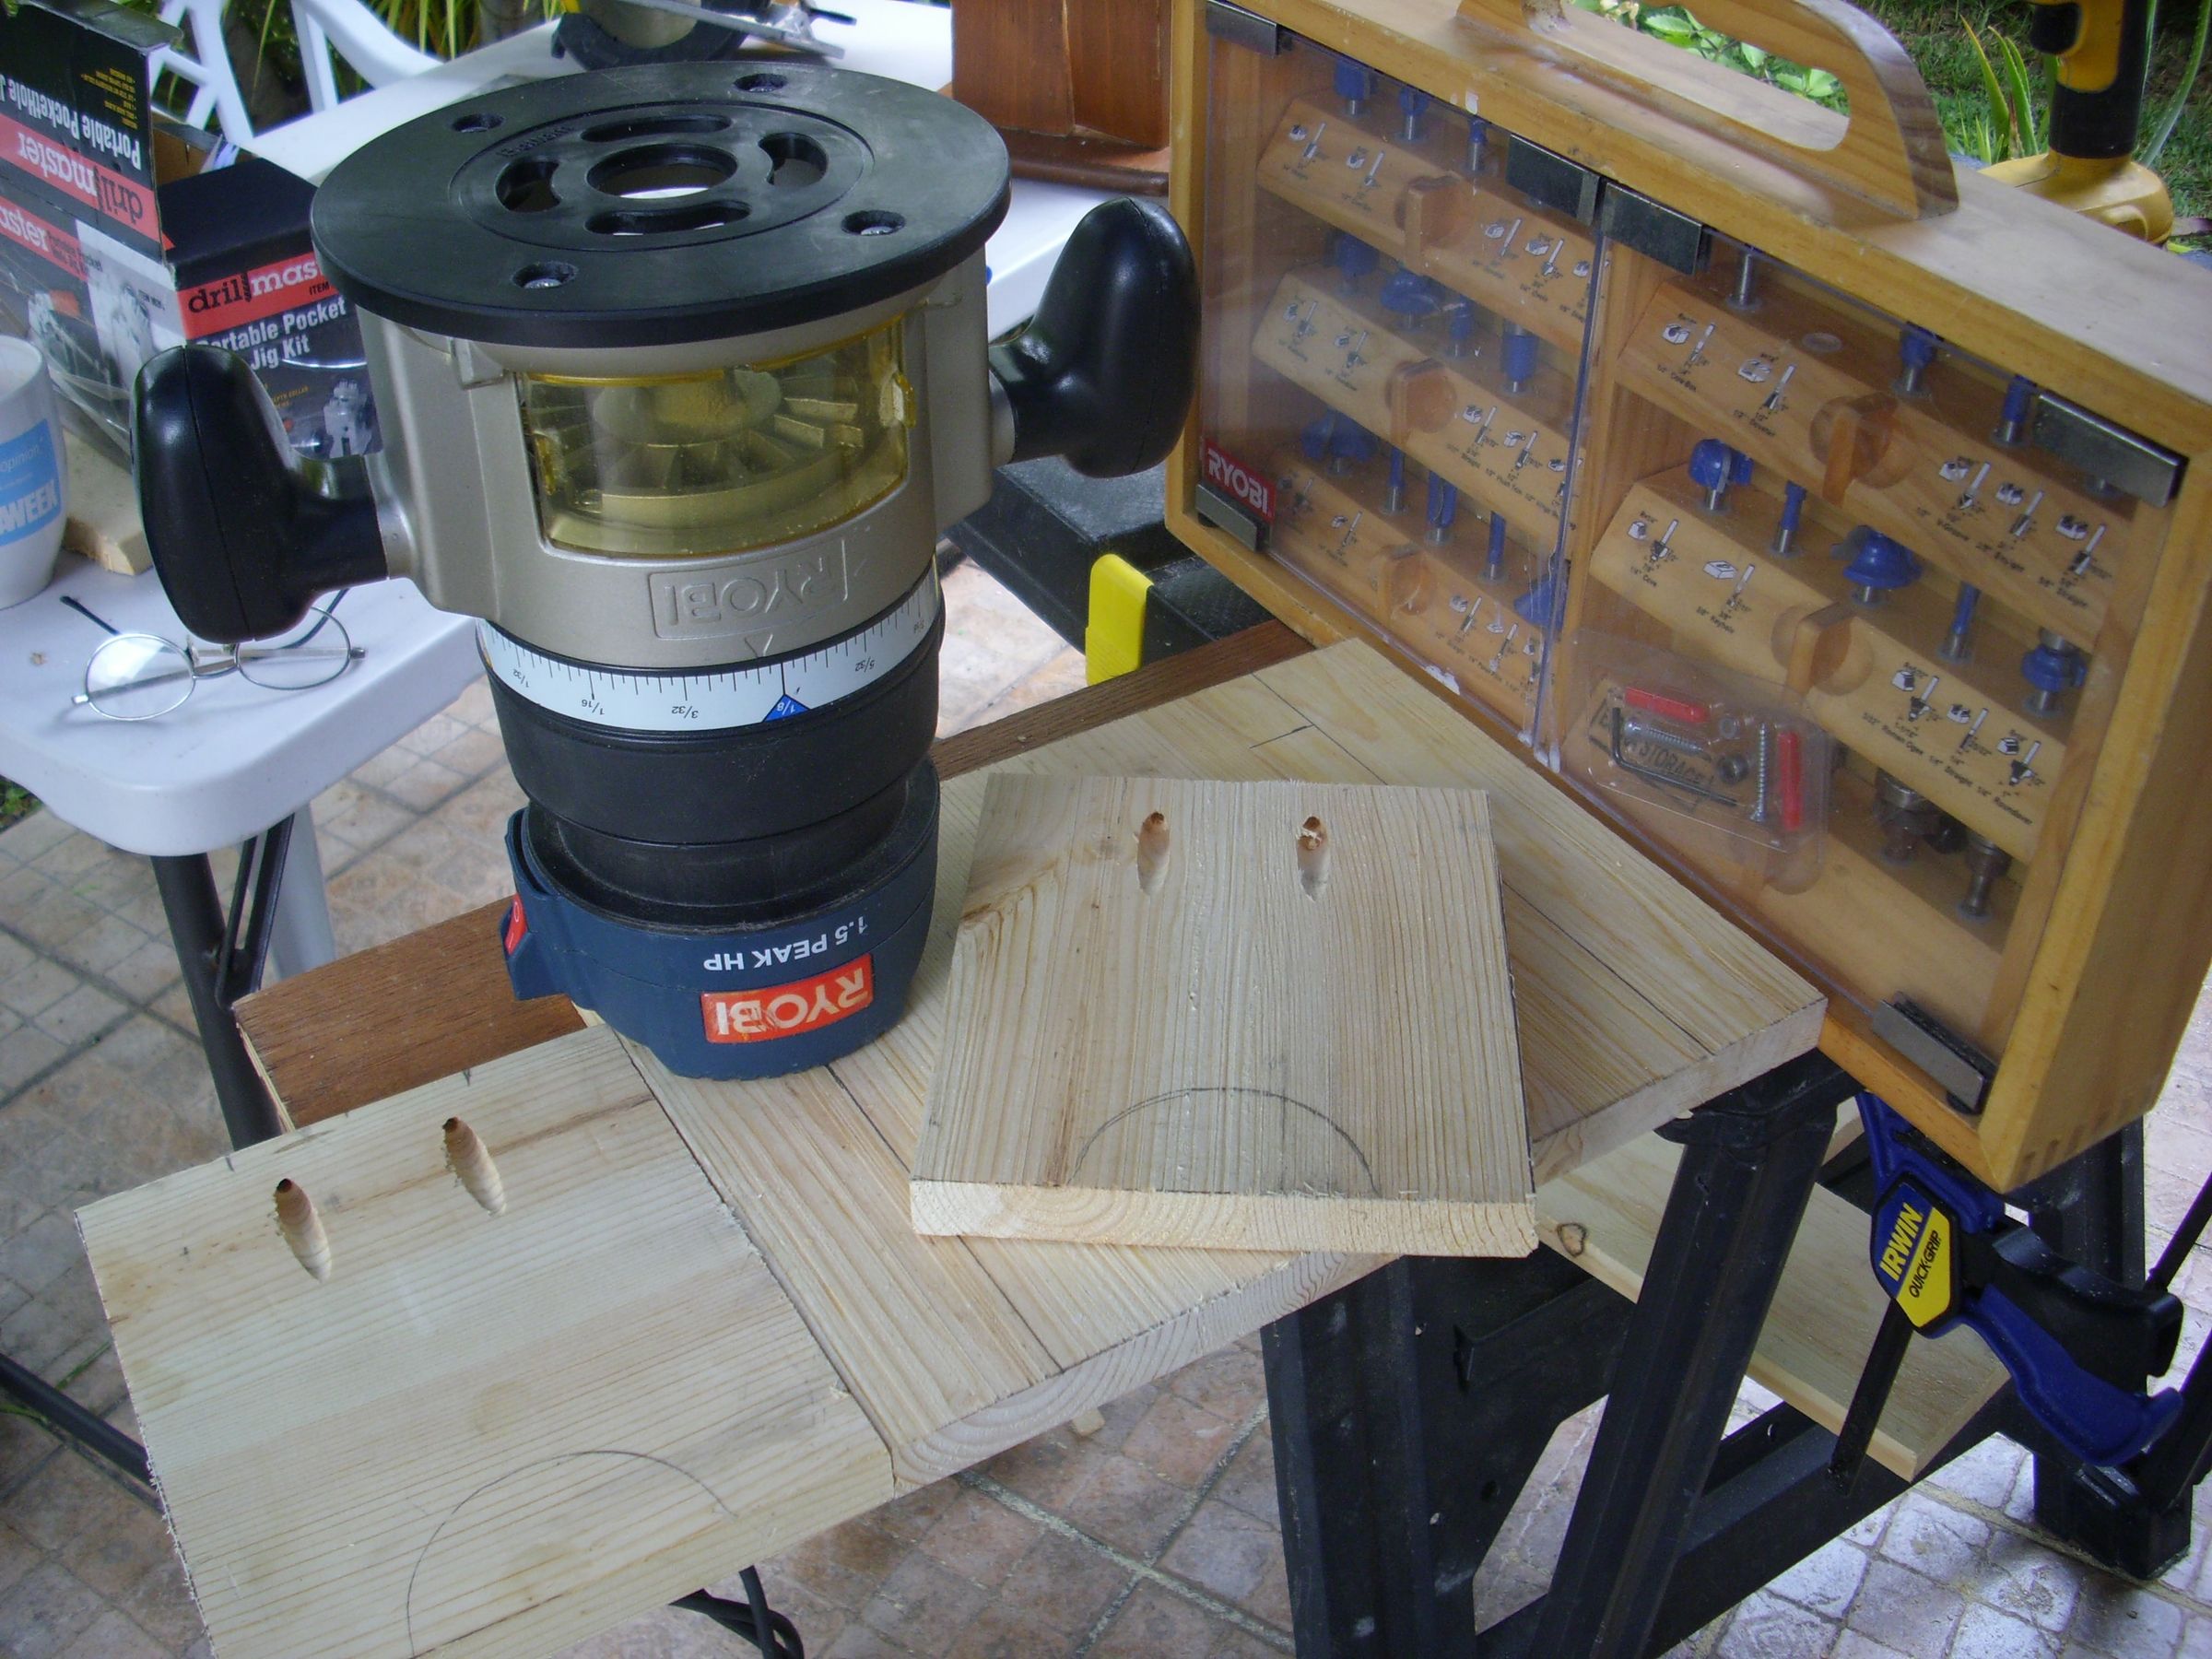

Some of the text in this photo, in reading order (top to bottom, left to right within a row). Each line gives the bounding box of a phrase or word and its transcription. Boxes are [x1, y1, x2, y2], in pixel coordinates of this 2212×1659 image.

[81, 114, 142, 171] Portable
[0, 206, 49, 251] aster
[251, 261, 318, 297] mas
[309, 280, 330, 295] ITEM
[196, 295, 347, 351] rtable Pocket
[251, 334, 311, 370] Jig Kit
[1206, 448, 1269, 514] RYOBI
[663, 556, 826, 626] RYOBI
[512, 668, 531, 688] 1/32
[854, 658, 877, 674] 5/32
[581, 699, 606, 716] 1/16
[671, 705, 699, 720] 3/32
[776, 701, 796, 714] 1/8
[703, 916, 867, 971] 1.5 PEAK HP
[715, 967, 868, 1035] RYOBI
[1879, 1201, 1924, 1281] IRWIN
